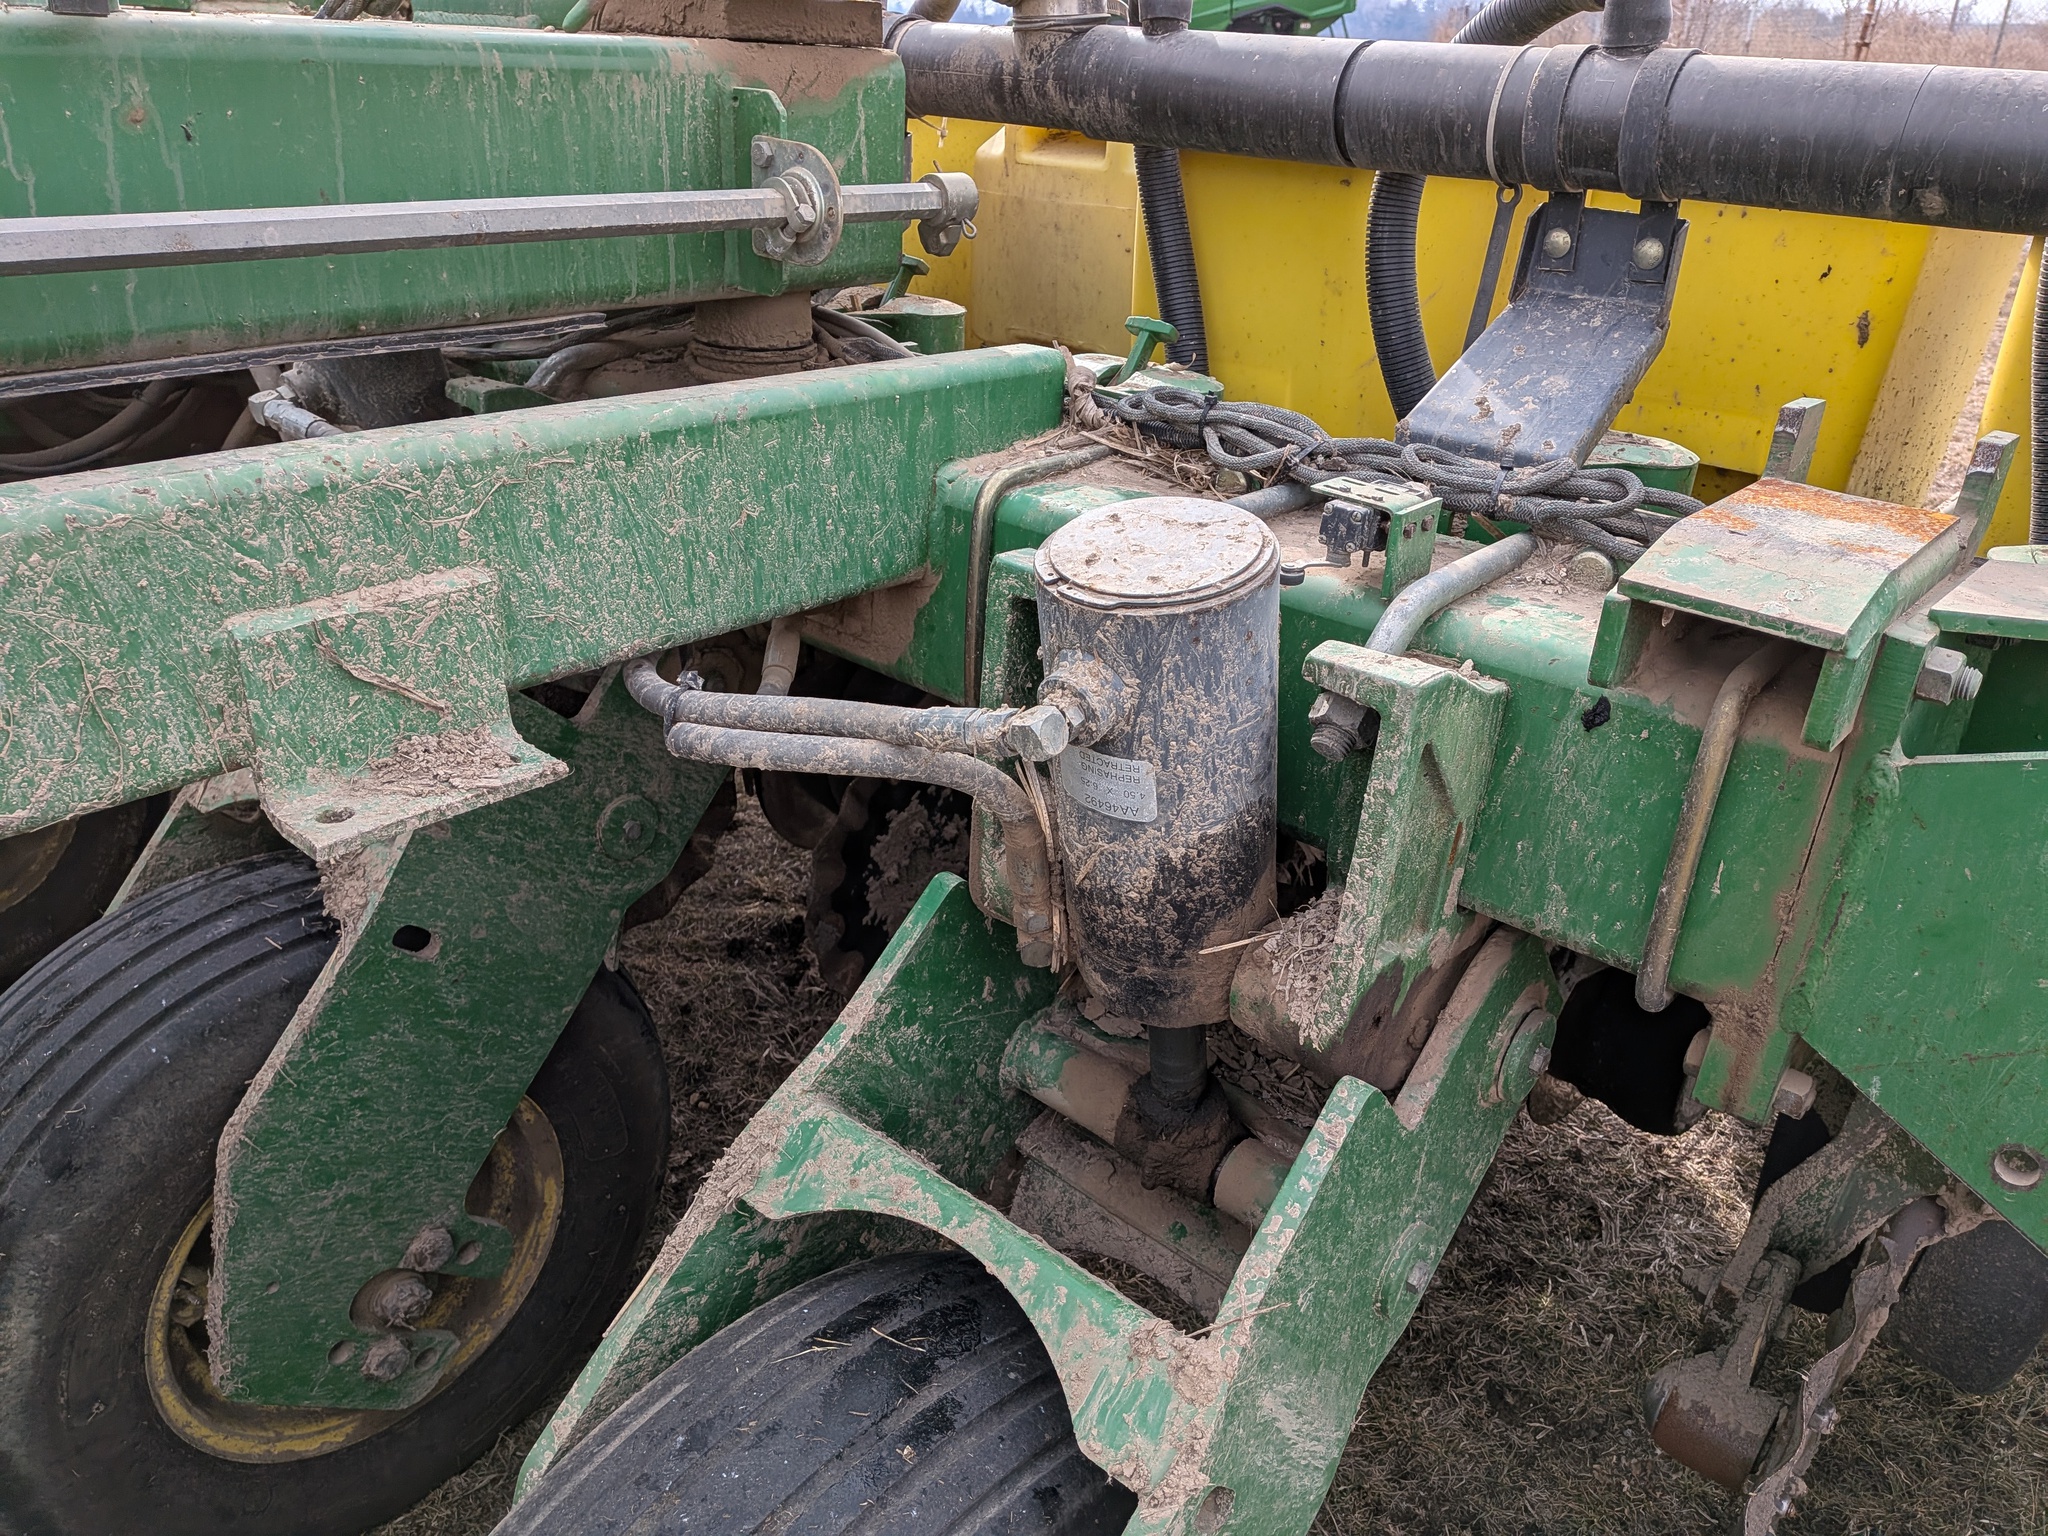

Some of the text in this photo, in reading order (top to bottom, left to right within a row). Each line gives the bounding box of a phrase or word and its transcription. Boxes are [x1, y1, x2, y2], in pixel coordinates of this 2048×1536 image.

[1079, 750, 1140, 773] RETRACTED
[1080, 776, 1099, 790] 6.25
[1081, 762, 1141, 784] REPHASING
[1085, 793, 1139, 817] AA46492
[1123, 789, 1146, 800] 4.50
